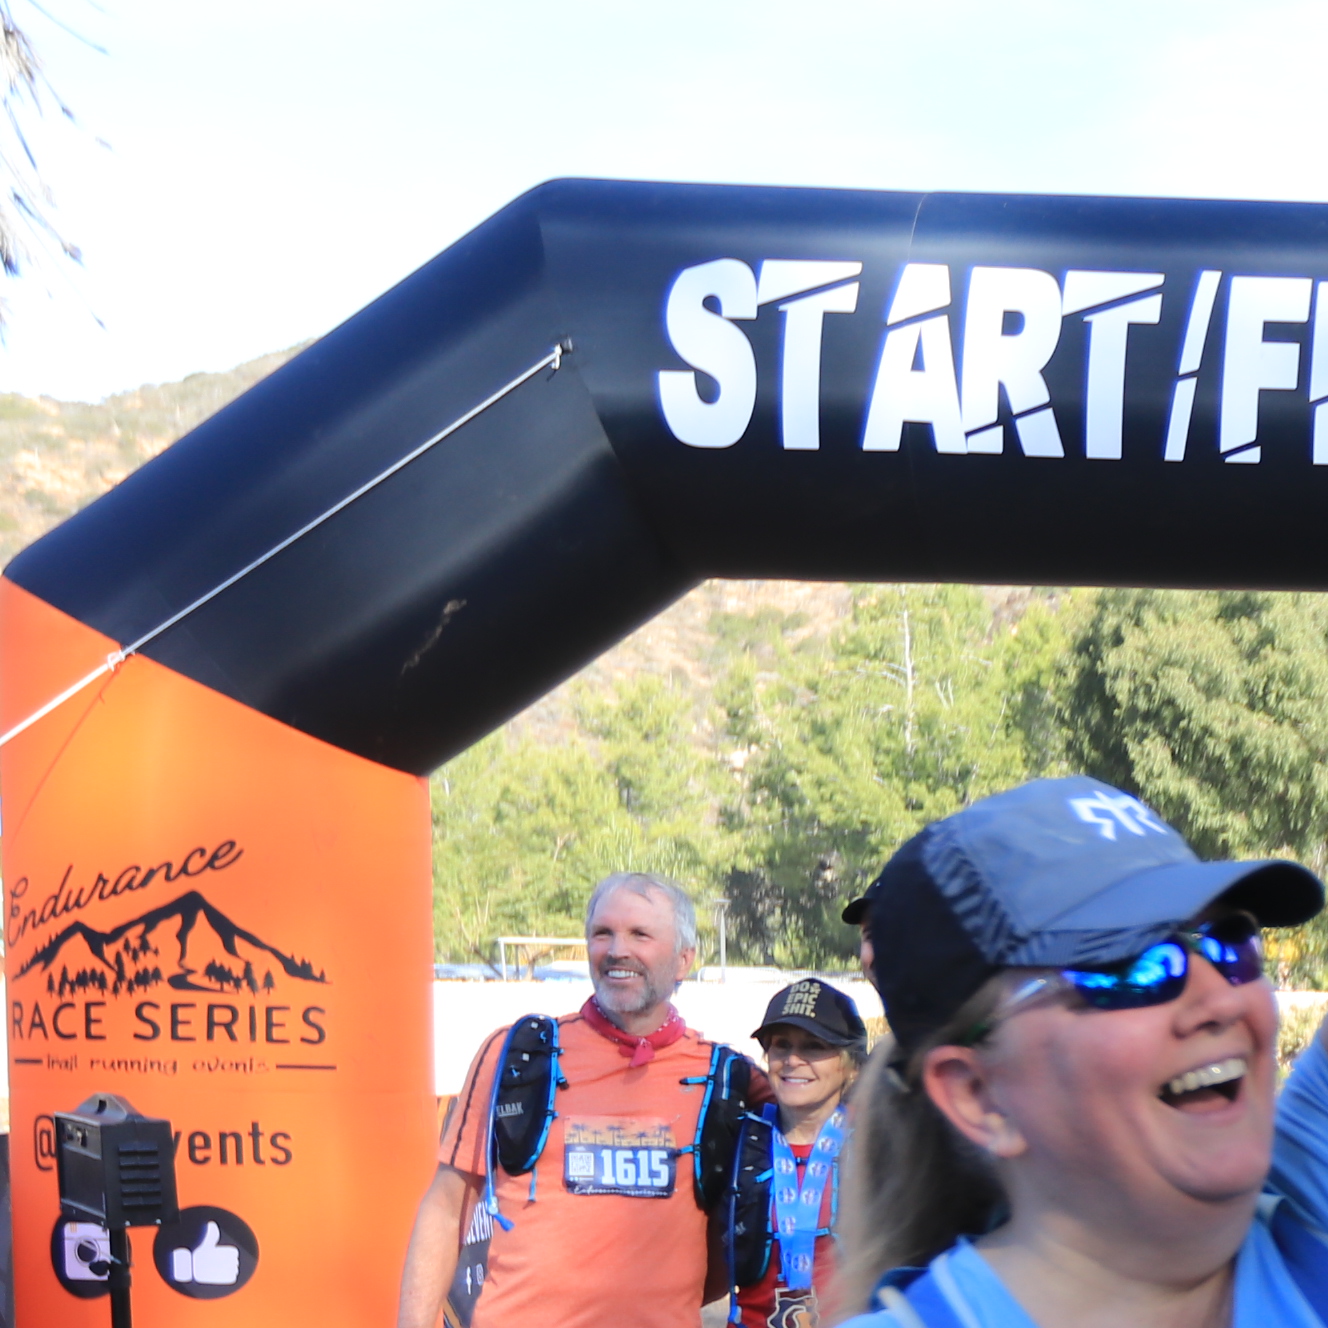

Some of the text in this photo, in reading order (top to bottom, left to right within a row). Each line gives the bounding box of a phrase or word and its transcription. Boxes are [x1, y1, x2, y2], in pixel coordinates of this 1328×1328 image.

[7, 839, 245, 948] Endurance
[12, 1001, 327, 1045] RACE SERIES
[89, 1056, 178, 1076] running
[600, 1149, 670, 1188] 1615
